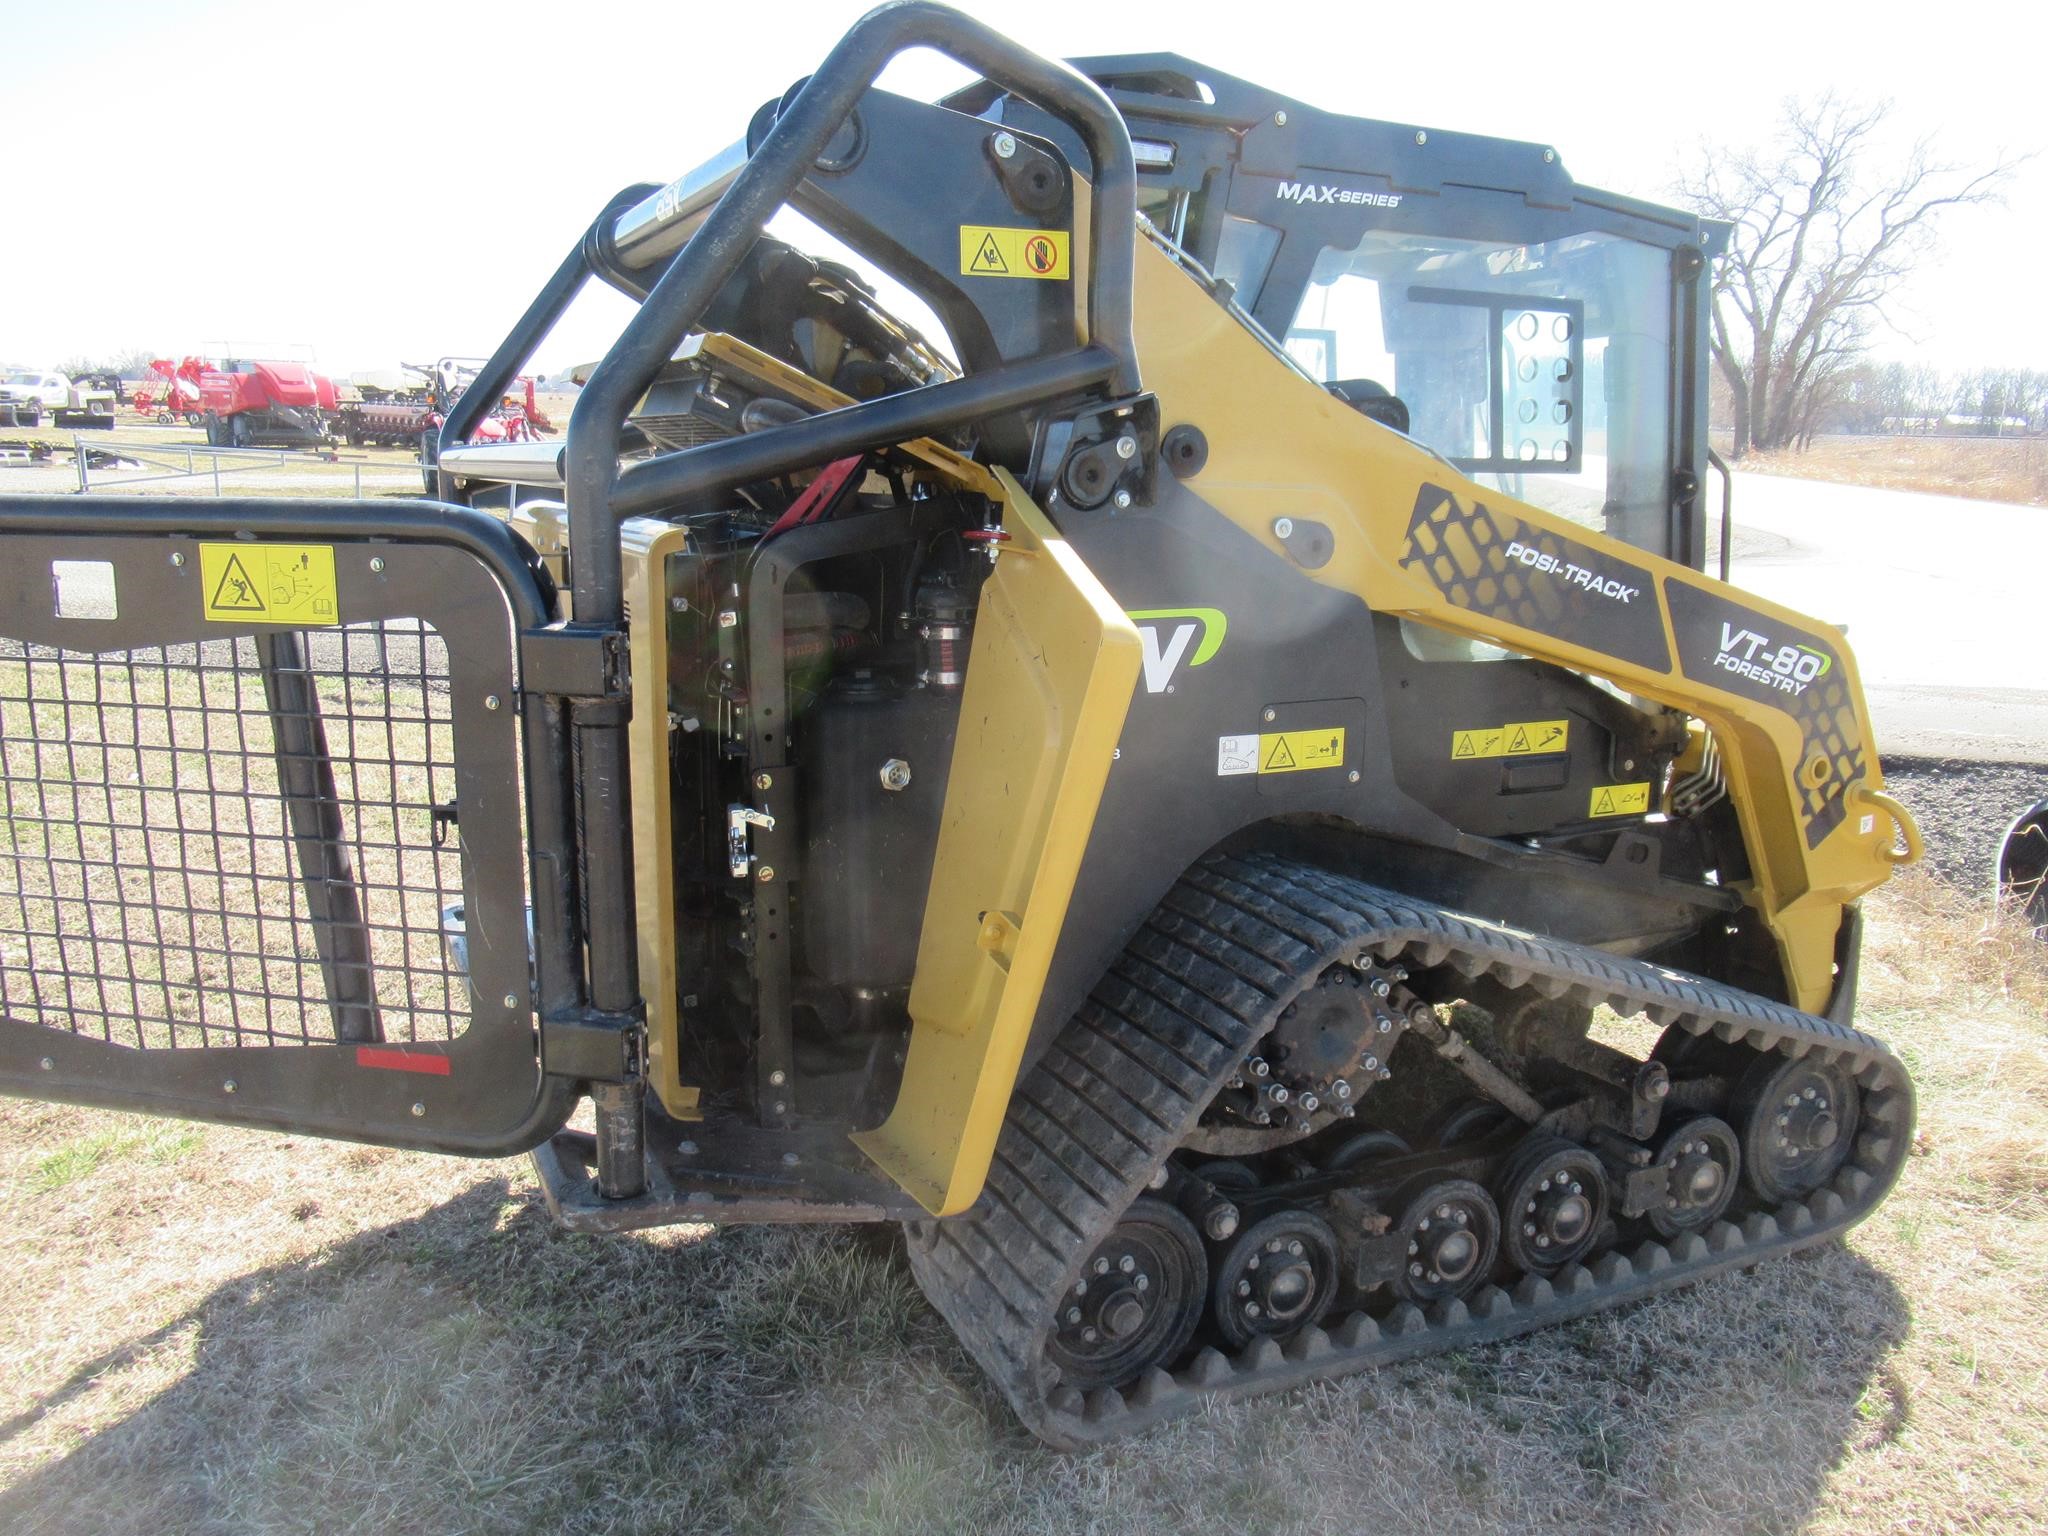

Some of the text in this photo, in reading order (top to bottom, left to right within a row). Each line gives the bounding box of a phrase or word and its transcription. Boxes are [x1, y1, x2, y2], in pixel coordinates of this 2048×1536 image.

[1276, 181, 1401, 208] MAX-SERIES
[1505, 541, 1637, 603] POSI-TRACK
[1713, 652, 1808, 696] FORESTRY
[1720, 622, 1820, 682] VT-80
